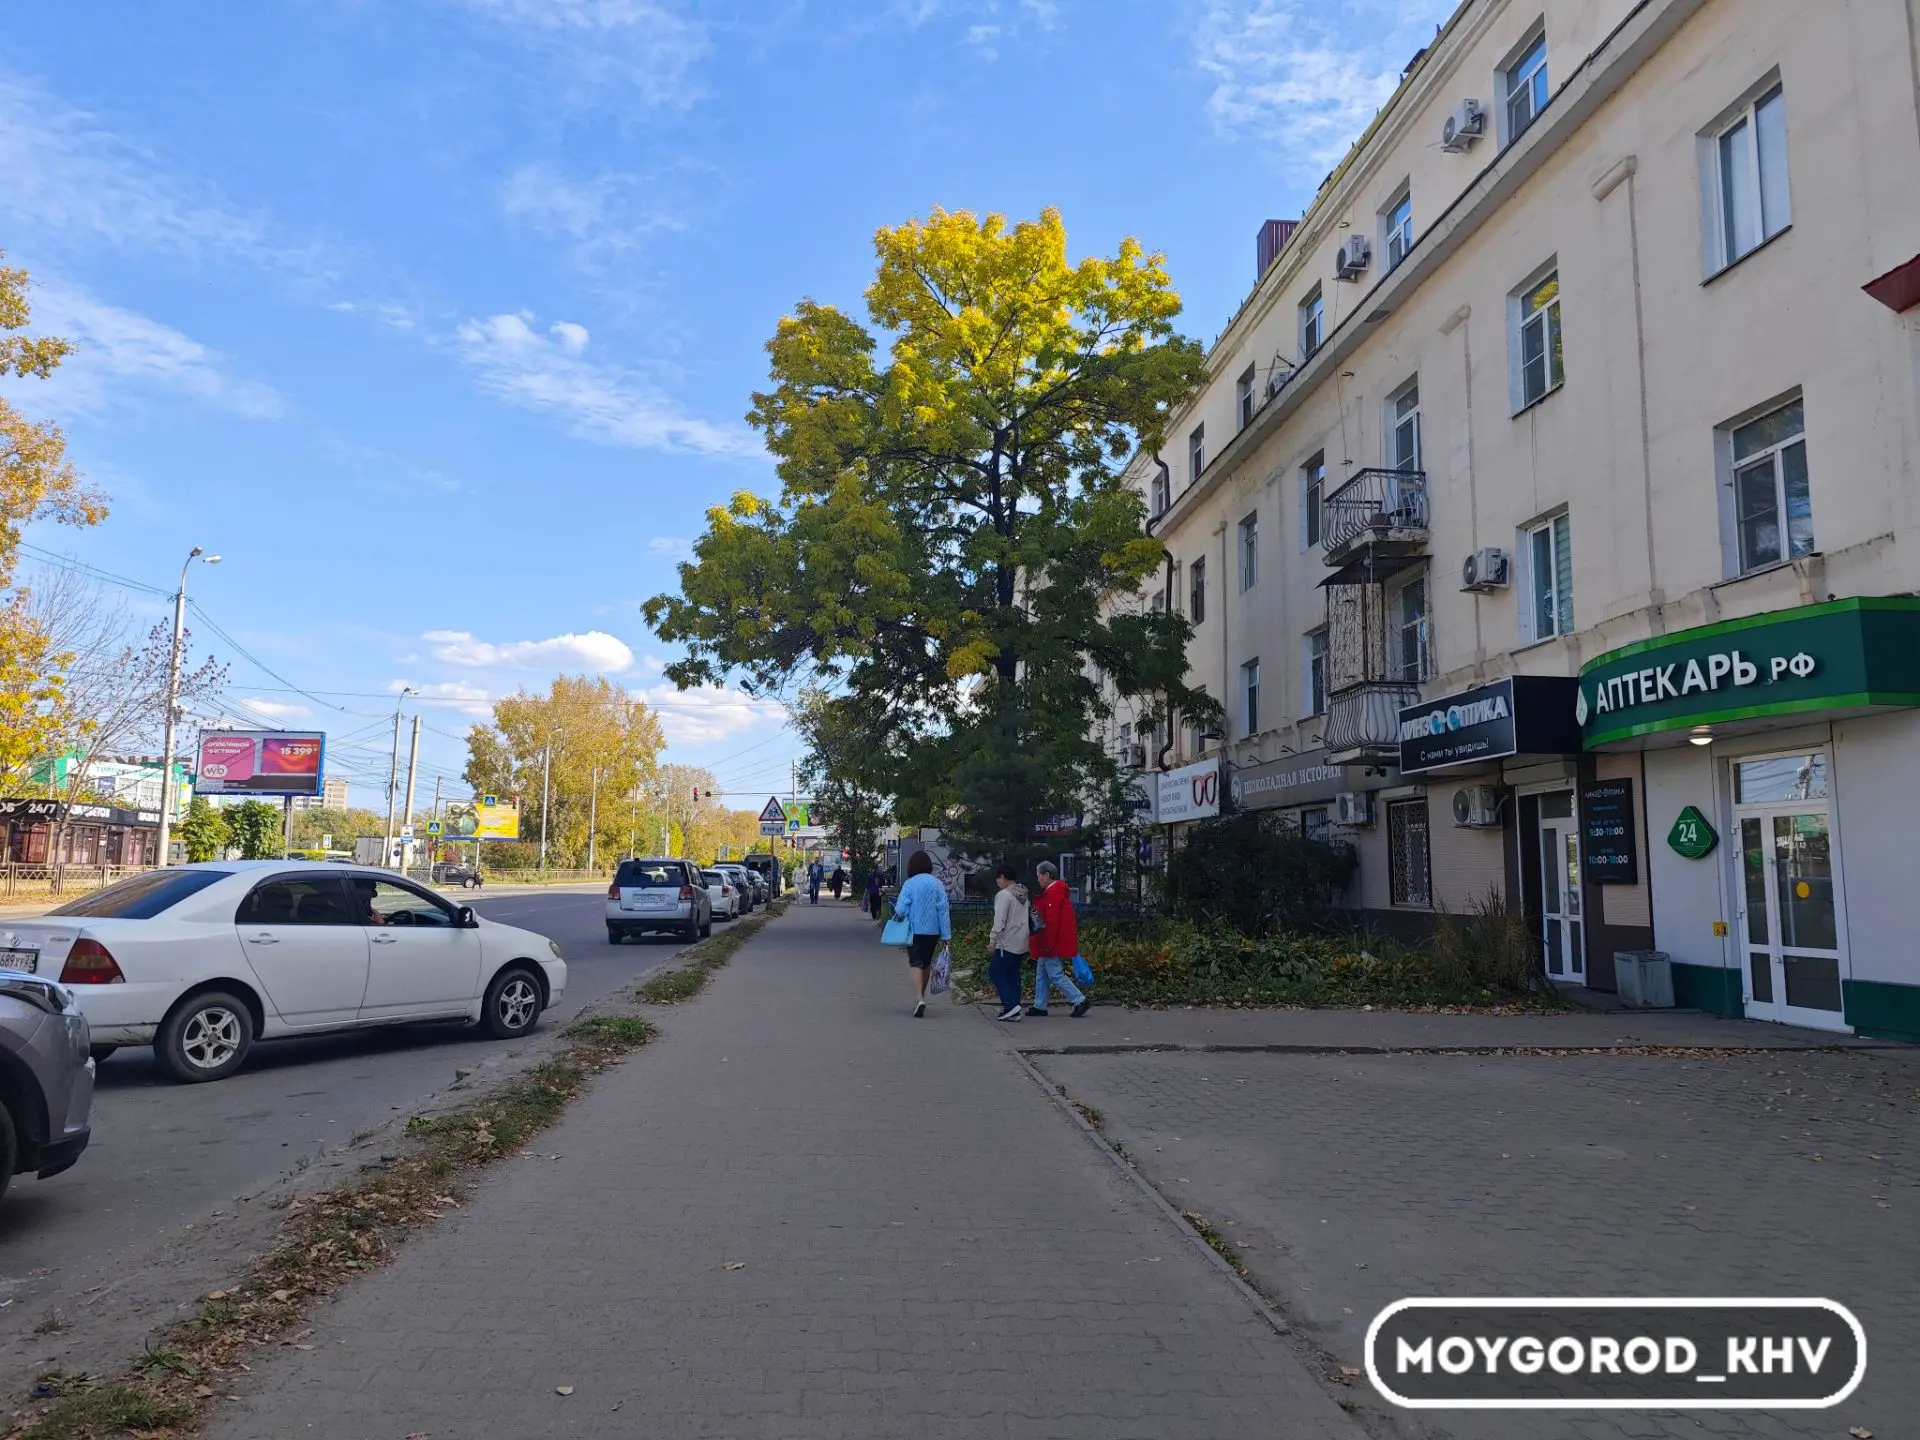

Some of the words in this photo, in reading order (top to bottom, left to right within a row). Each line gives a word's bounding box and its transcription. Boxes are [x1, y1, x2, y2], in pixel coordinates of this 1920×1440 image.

[1596, 650, 1757, 714] АПТЕКАРЬ
[281, 747, 291, 755] 15
[1420, 750, 1426, 761] С
[1427, 749, 1444, 760] нами
[1444, 748, 1454, 756] ты
[1455, 738, 1489, 757] увидишь!
[1243, 772, 1297, 794] ШОКОЛАДНАЯ
[1299, 765, 1341, 784] ИСТОРИЯ
[28, 803, 57, 814] 24/7
[1035, 824, 1059, 832] STYLE
[1679, 823, 1698, 842] 24
